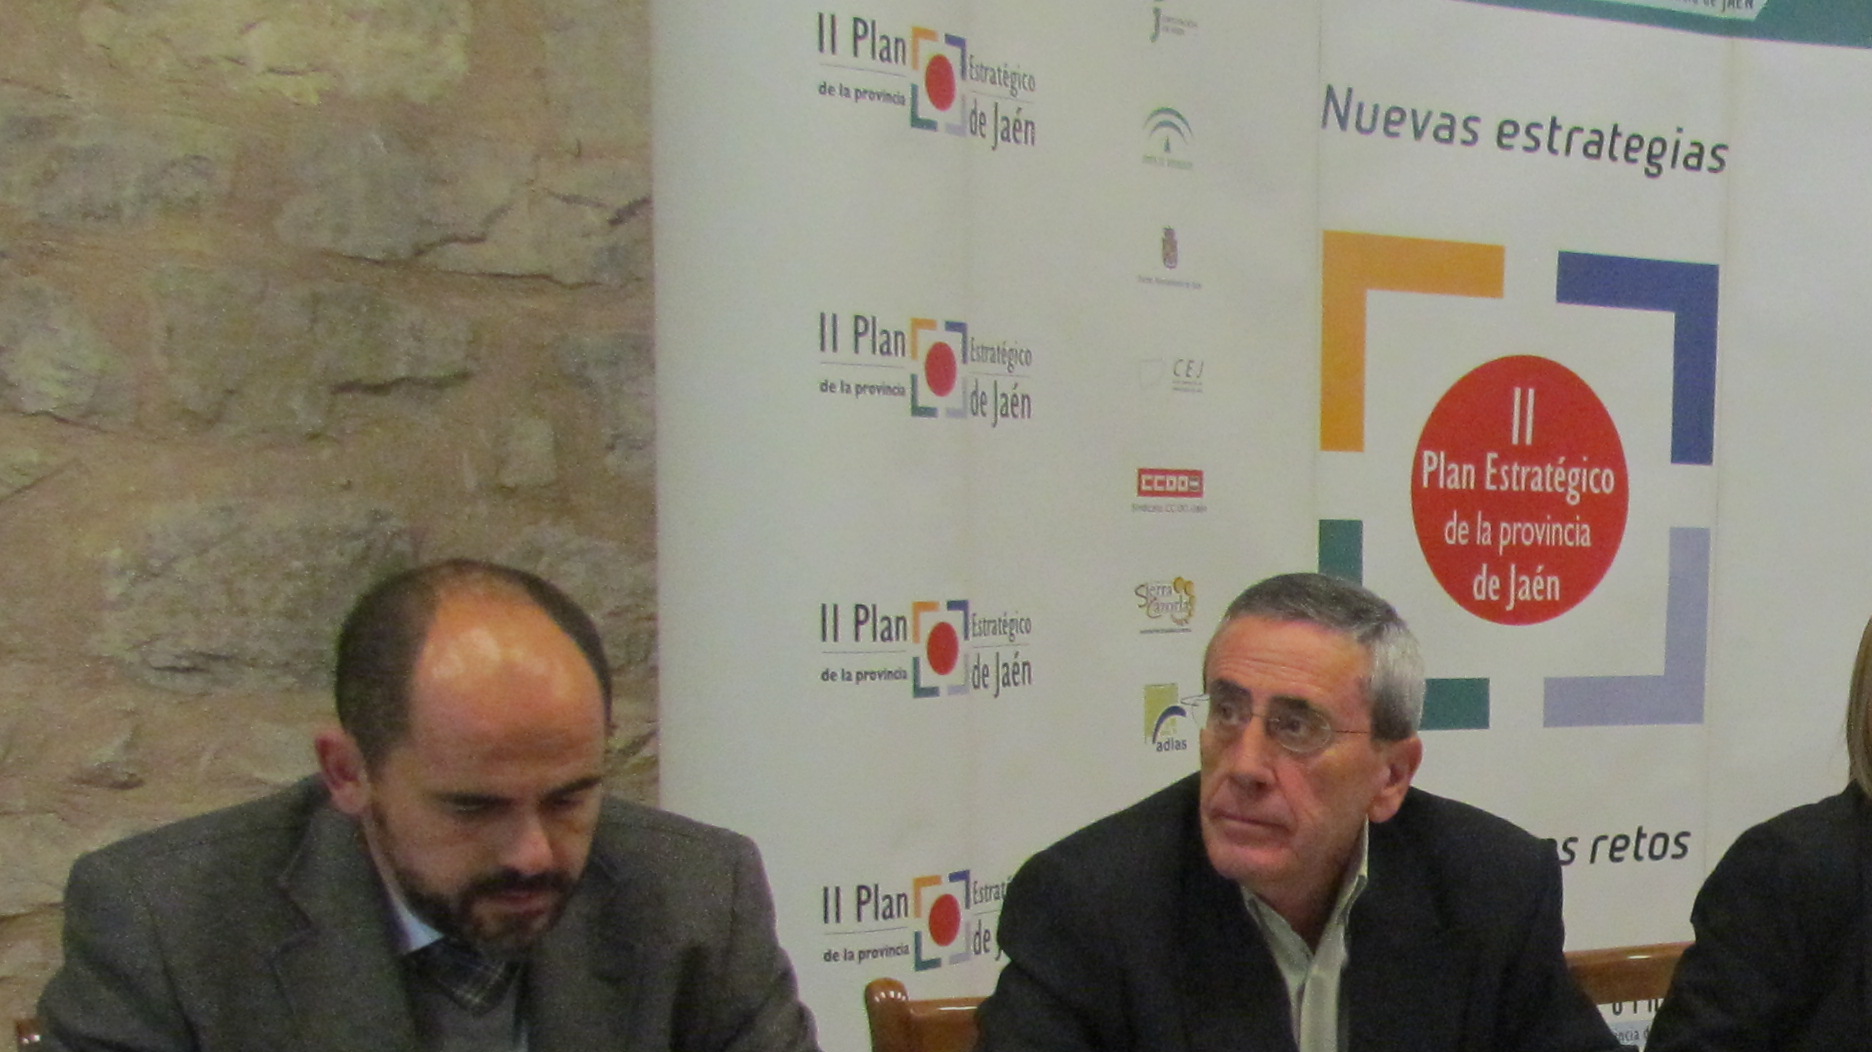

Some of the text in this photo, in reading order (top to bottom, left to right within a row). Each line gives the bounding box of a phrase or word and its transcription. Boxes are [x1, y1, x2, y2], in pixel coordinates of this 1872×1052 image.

[817, 13, 907, 66] II Plan
[818, 82, 907, 107] de la provincia
[968, 56, 1037, 97] Estratégico
[969, 101, 1037, 151] de Jaén
[1320, 84, 1730, 180] Nuevas estrategias
[819, 312, 907, 358] II Plan
[969, 338, 1033, 373] Estratégico
[820, 379, 906, 400] de la provincia
[970, 381, 1032, 429] de Jaén
[1512, 387, 1536, 446] II
[1422, 449, 1615, 505] Plan Estratégico
[1445, 510, 1592, 556] de la provincia
[1473, 564, 1560, 611] de Jaén
[820, 603, 908, 643] II Plan
[971, 611, 1033, 642] Estratégico
[820, 667, 908, 684] de la provincia
[971, 652, 1033, 698] de Jaén
[1590, 826, 1692, 865] retos
[823, 883, 910, 924] II Plan
[972, 879, 1008, 905] Estrat
[824, 944, 910, 963] de la provincia
[973, 919, 991, 955] de
